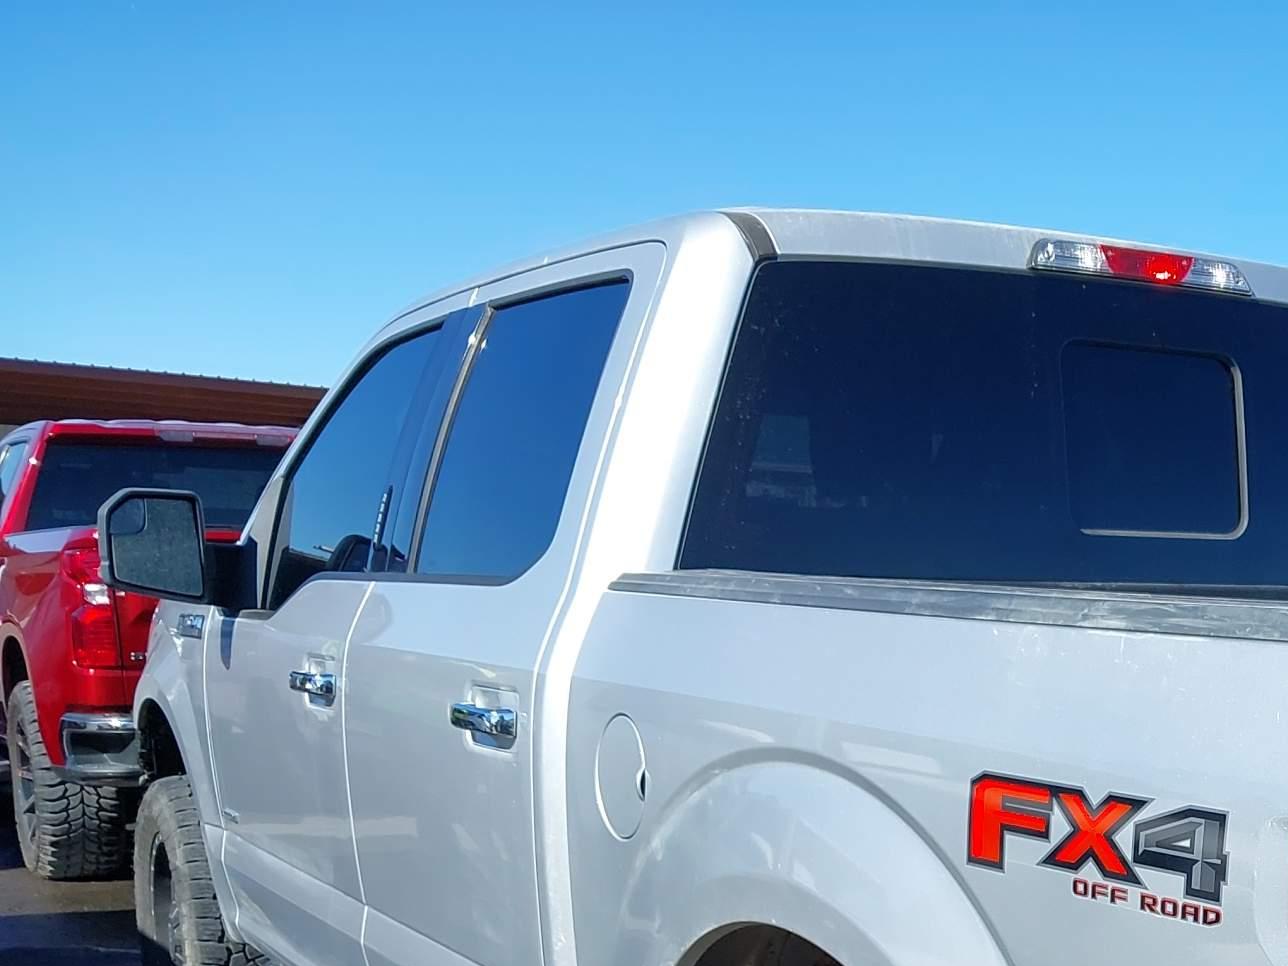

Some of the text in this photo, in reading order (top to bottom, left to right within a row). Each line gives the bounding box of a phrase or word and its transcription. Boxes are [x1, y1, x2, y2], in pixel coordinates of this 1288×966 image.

[966, 770, 1229, 906] FX4
[1072, 878, 1223, 927] OFF ROAD
